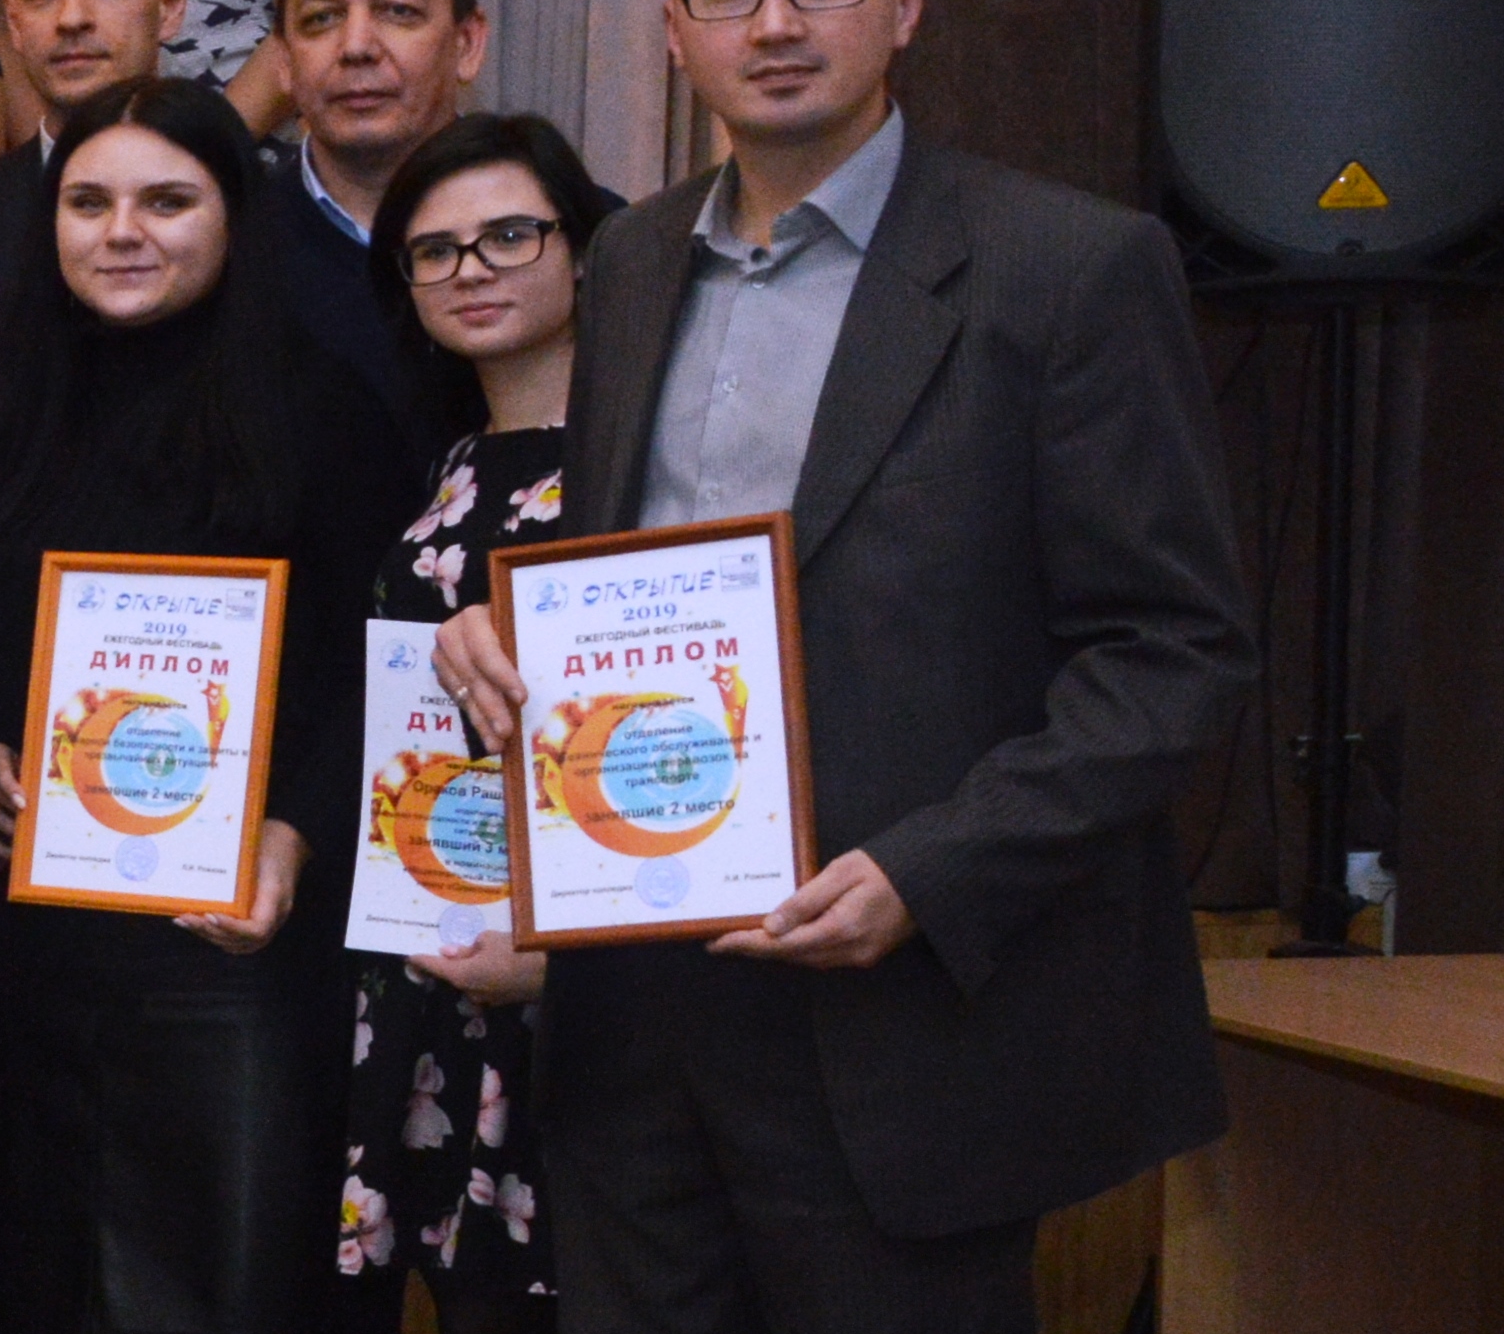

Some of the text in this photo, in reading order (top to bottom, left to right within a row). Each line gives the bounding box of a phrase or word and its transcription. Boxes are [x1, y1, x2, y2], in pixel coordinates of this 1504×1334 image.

[582, 569, 715, 606] ОТКРЫТИЕ
[115, 594, 221, 615] ОТКРЫТИЕ
[623, 602, 677, 623] 2019
[143, 622, 187, 636] 2019
[575, 619, 725, 645] ЕЖЕГОДНЫЙ ФЕСТИВАЛЬ
[103, 635, 163, 646] ЕЖЕГОДНЫЙ
[89, 650, 229, 675] ДИПЛОМ
[563, 636, 738, 676] ДИПЛОМ
[419, 696, 460, 707] ЕЖЕГО
[623, 723, 693, 740] отделение
[152, 787, 159, 799] 2
[163, 791, 203, 801] место
[670, 801, 679, 814] 2
[685, 798, 735, 813] место
[485, 841, 493, 853] 3
